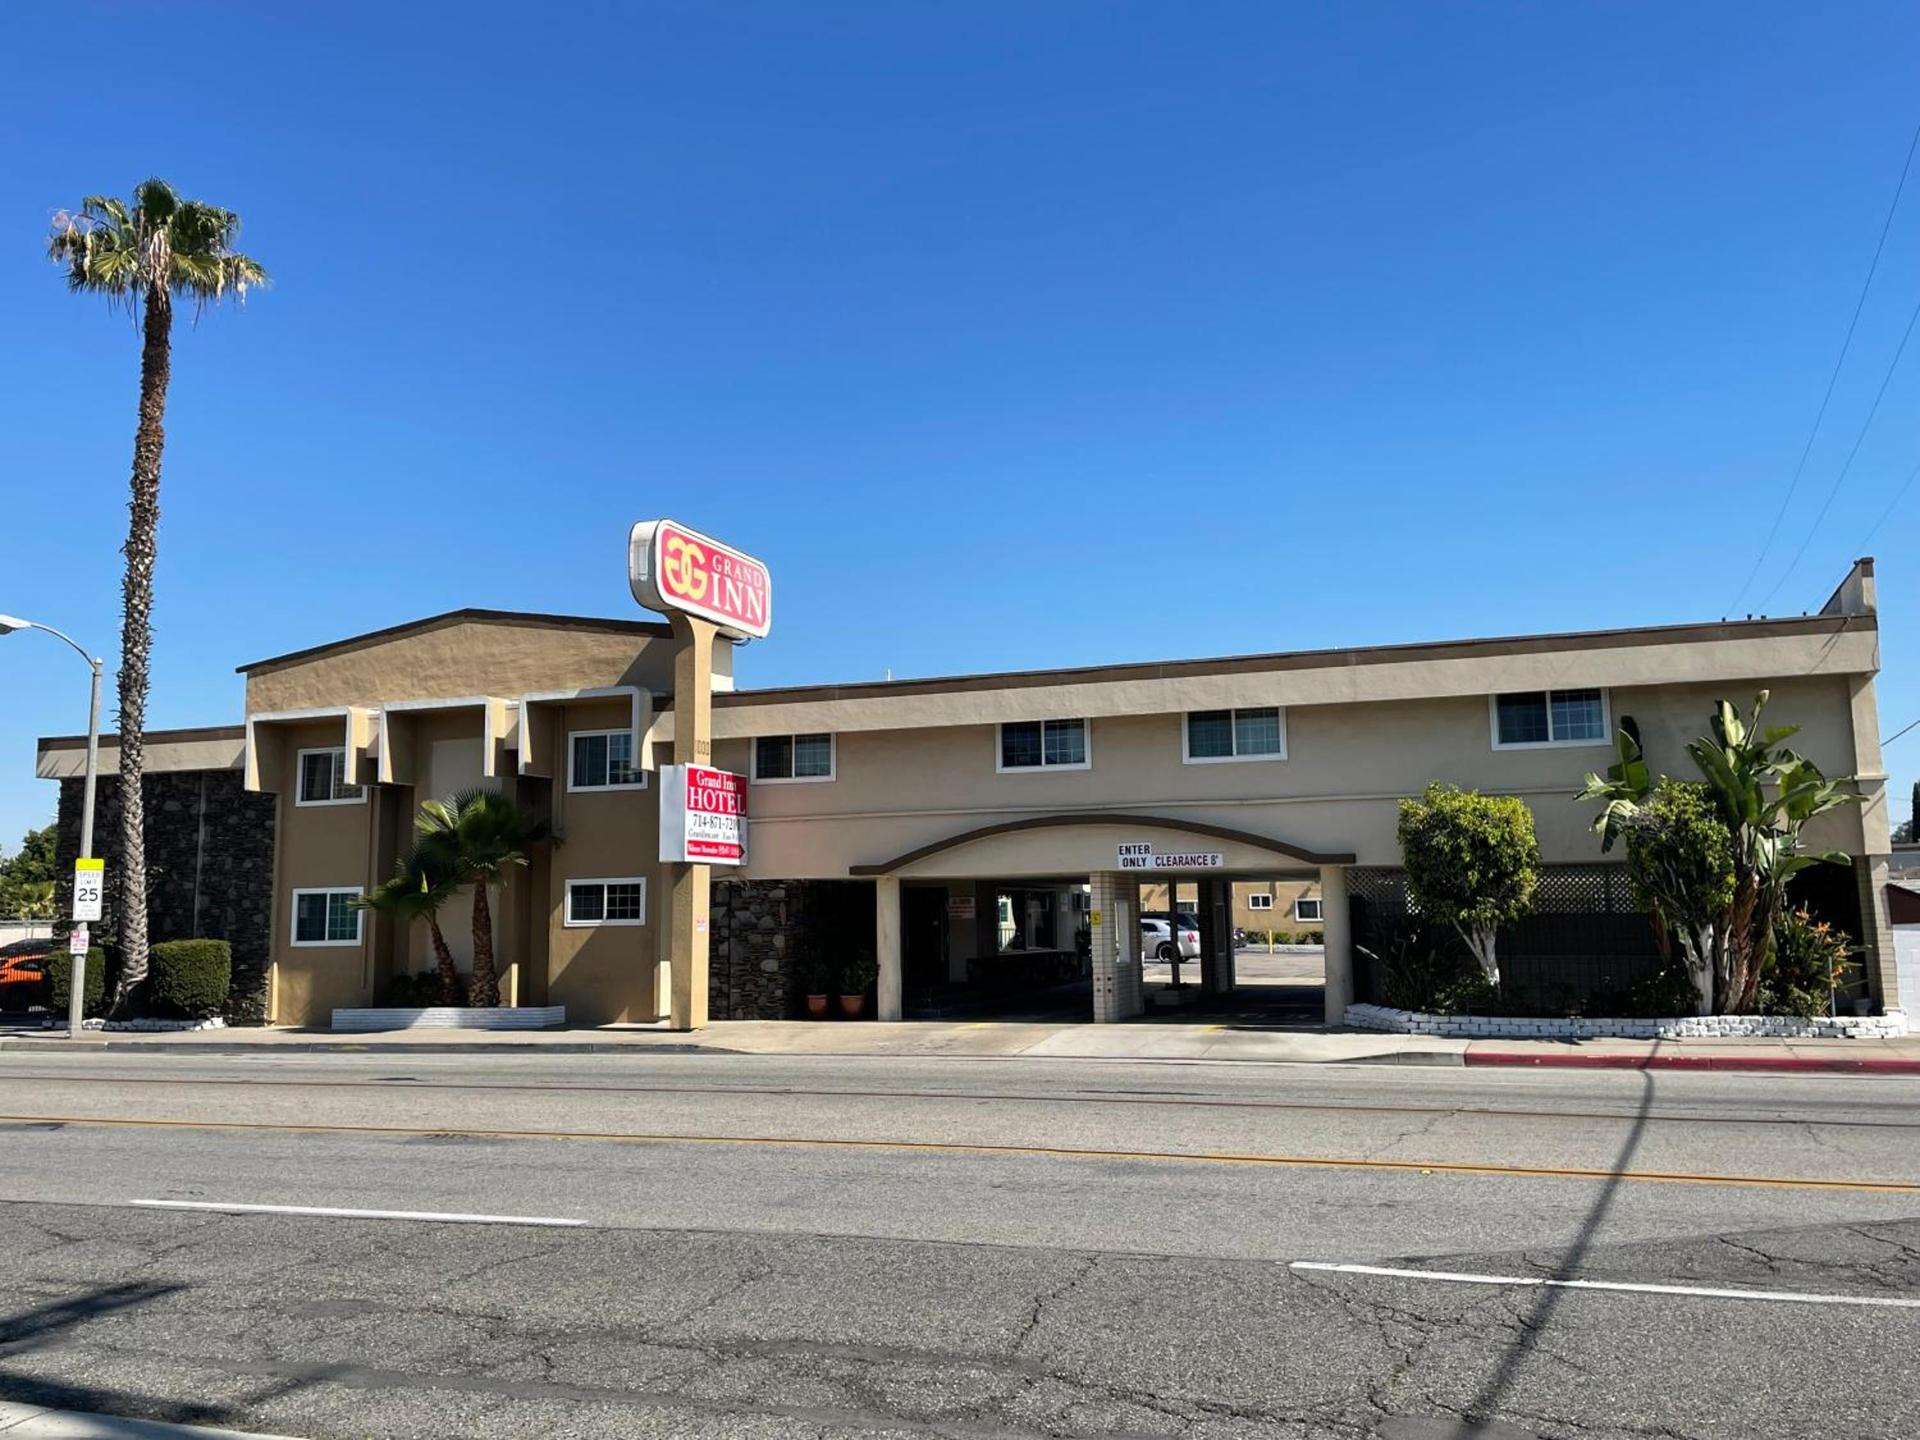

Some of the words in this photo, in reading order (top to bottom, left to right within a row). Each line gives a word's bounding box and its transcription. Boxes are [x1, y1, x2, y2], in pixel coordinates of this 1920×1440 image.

[712, 554, 763, 588] GRAND
[712, 572, 764, 621] INN
[696, 770, 722, 789] Grand
[723, 774, 737, 791] Inn
[688, 786, 746, 814] HOTEL
[1119, 844, 1151, 856] ENTER
[1122, 856, 1148, 868] ONLY
[1155, 855, 1208, 867] CLEARANCE
[78, 888, 98, 902] 25
